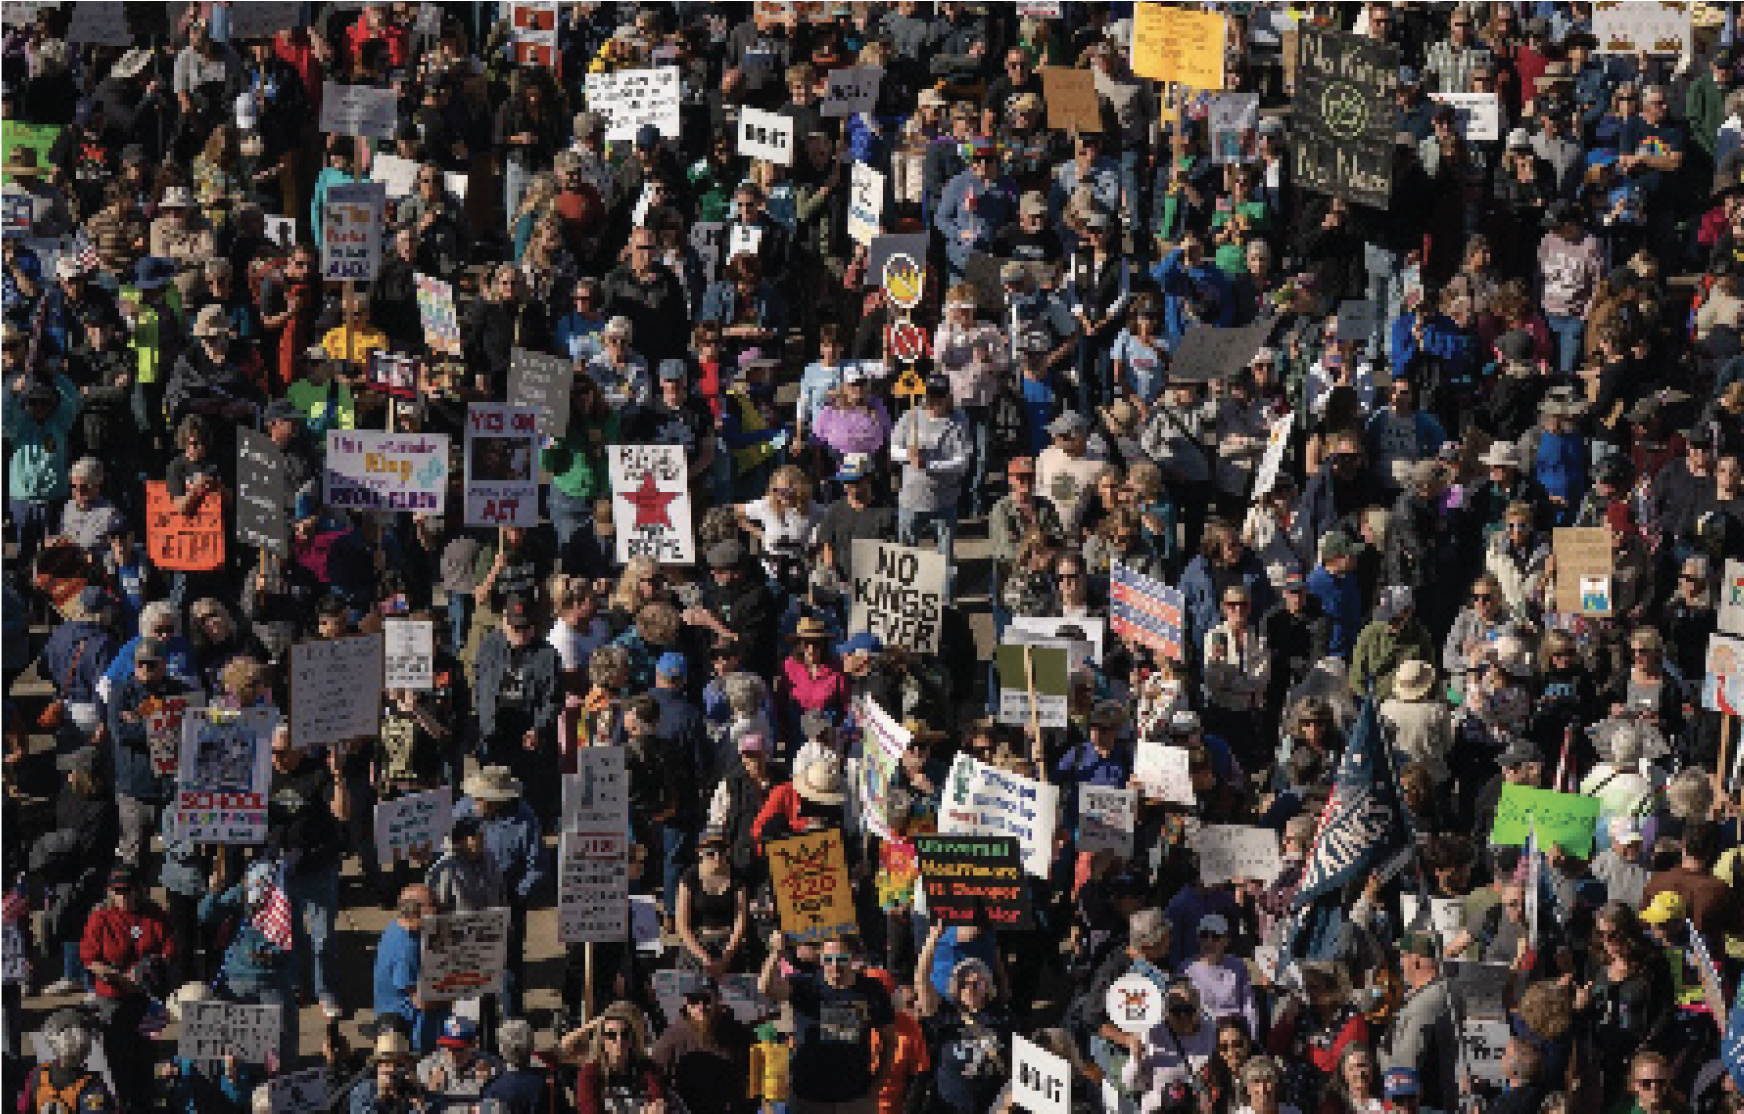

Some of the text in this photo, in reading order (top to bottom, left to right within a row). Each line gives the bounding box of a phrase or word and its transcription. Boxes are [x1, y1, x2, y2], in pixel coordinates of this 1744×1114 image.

[470, 409, 535, 433] YES ON
[365, 452, 414, 481] King
[482, 499, 519, 520] ACT
[876, 546, 919, 586] NO
[855, 577, 939, 621] KINGS
[866, 609, 935, 650] EVER
[181, 793, 269, 810] SCHOOL
